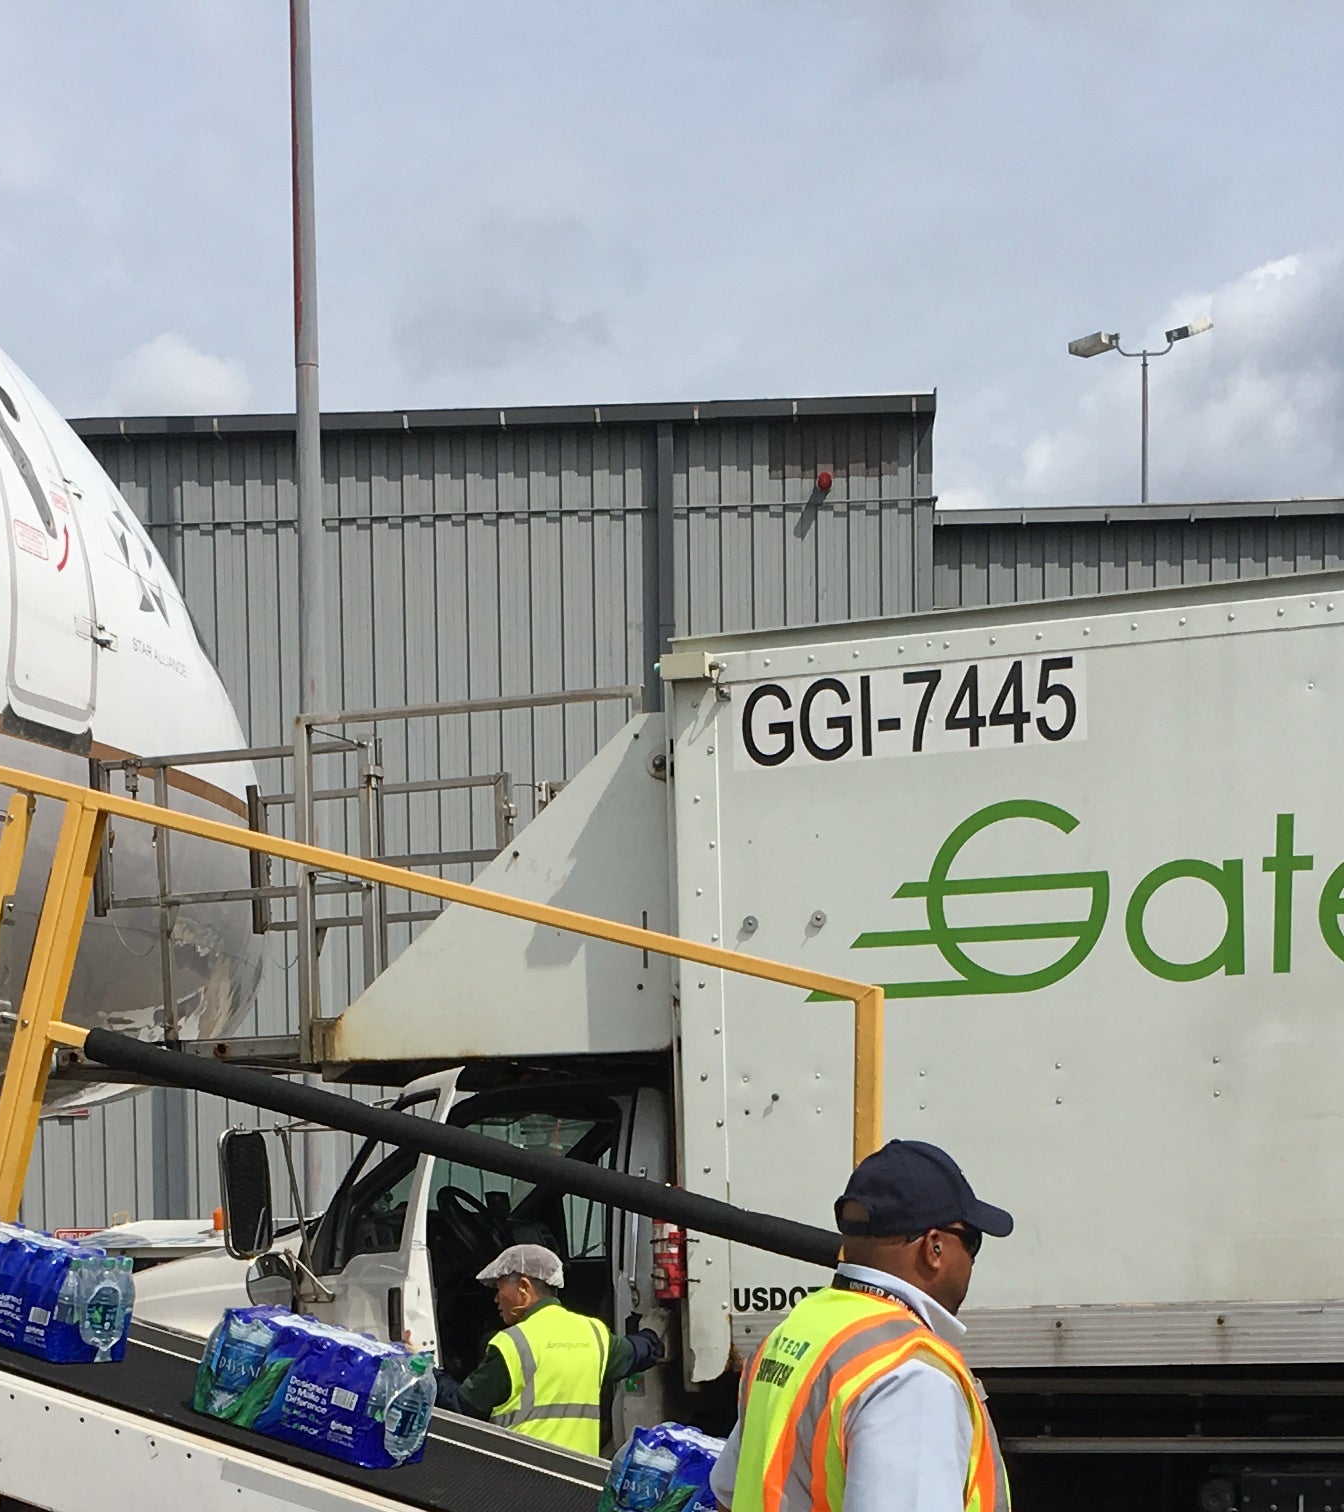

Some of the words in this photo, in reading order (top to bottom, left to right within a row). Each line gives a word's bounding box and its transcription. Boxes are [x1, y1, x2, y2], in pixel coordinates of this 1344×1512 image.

[742, 656, 1078, 767] GGI-7445
[849, 1282, 885, 1297] UNITED
[290, 1375, 329, 1397] Designed
[297, 1387, 320, 1404] Make
